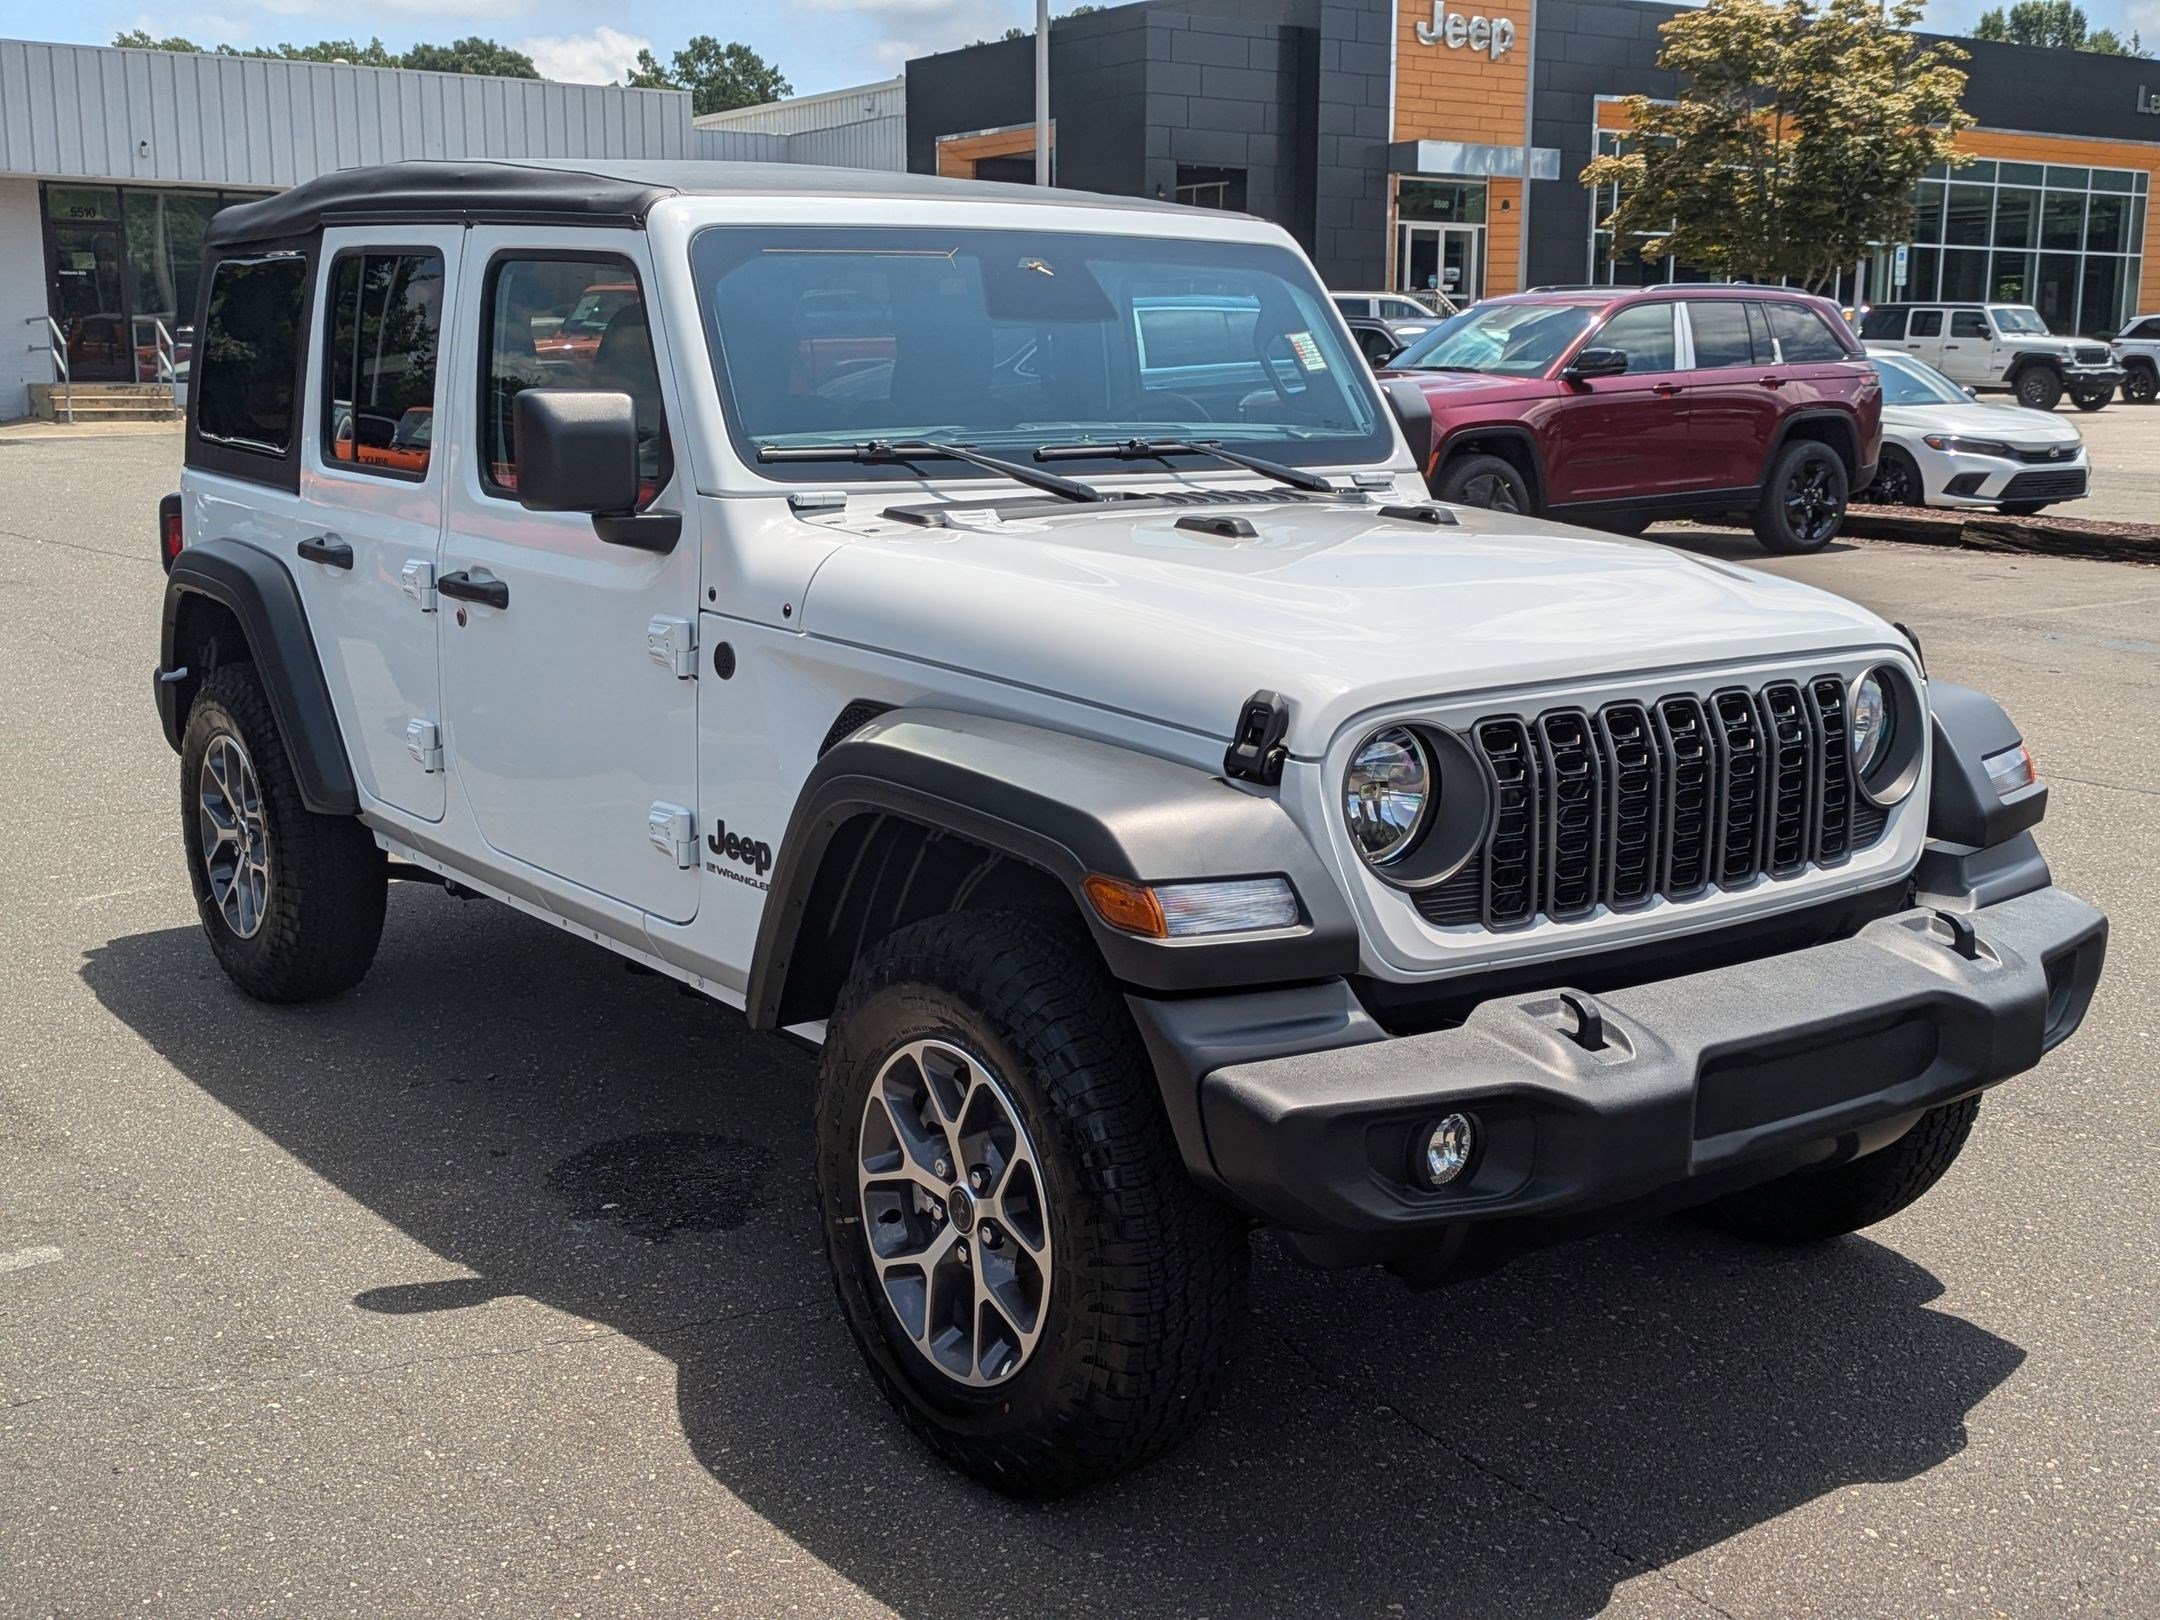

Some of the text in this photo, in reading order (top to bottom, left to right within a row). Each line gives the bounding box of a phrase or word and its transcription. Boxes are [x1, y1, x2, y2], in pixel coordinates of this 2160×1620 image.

[1416, 0, 1515, 61] Jeep
[69, 206, 97, 218] 5510
[707, 818, 772, 877] Jeep
